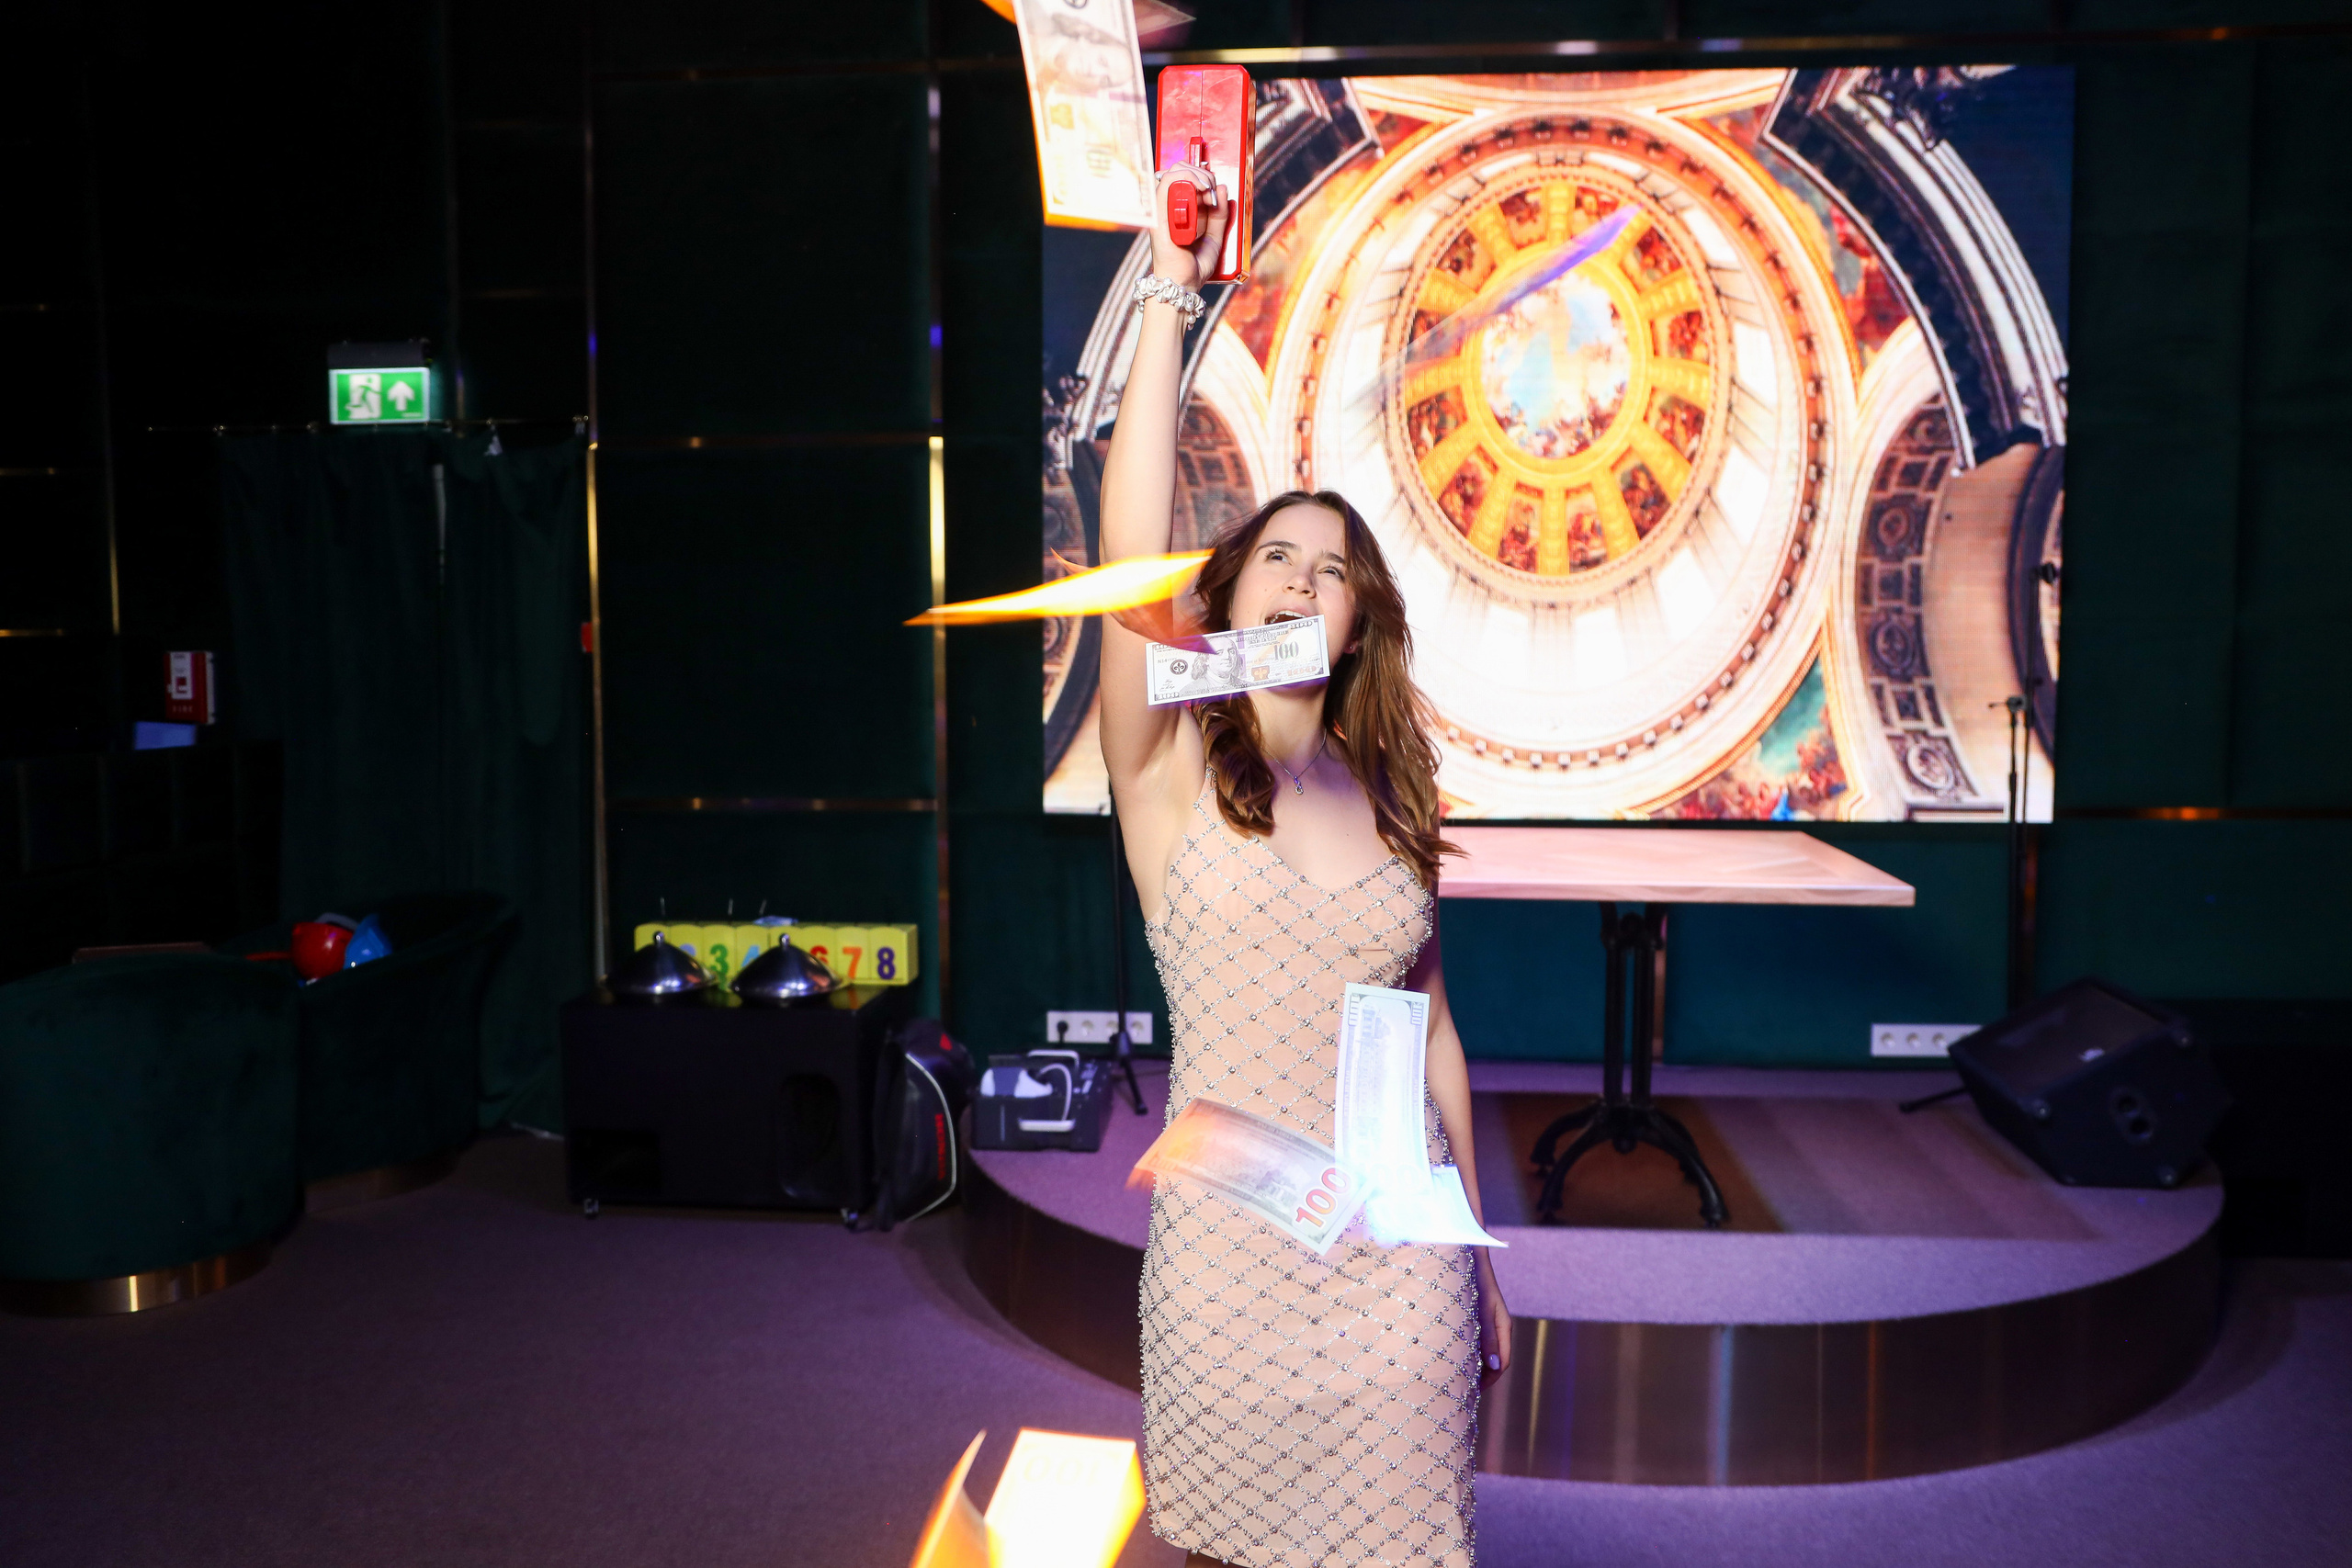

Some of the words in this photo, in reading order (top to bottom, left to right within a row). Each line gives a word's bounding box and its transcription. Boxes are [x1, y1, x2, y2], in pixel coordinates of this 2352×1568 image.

[1273, 641, 1299, 660] 100
[710, 943, 729, 976] 3
[842, 946, 862, 979] 7
[876, 946, 896, 980] 8
[1295, 1168, 1351, 1227] 100
